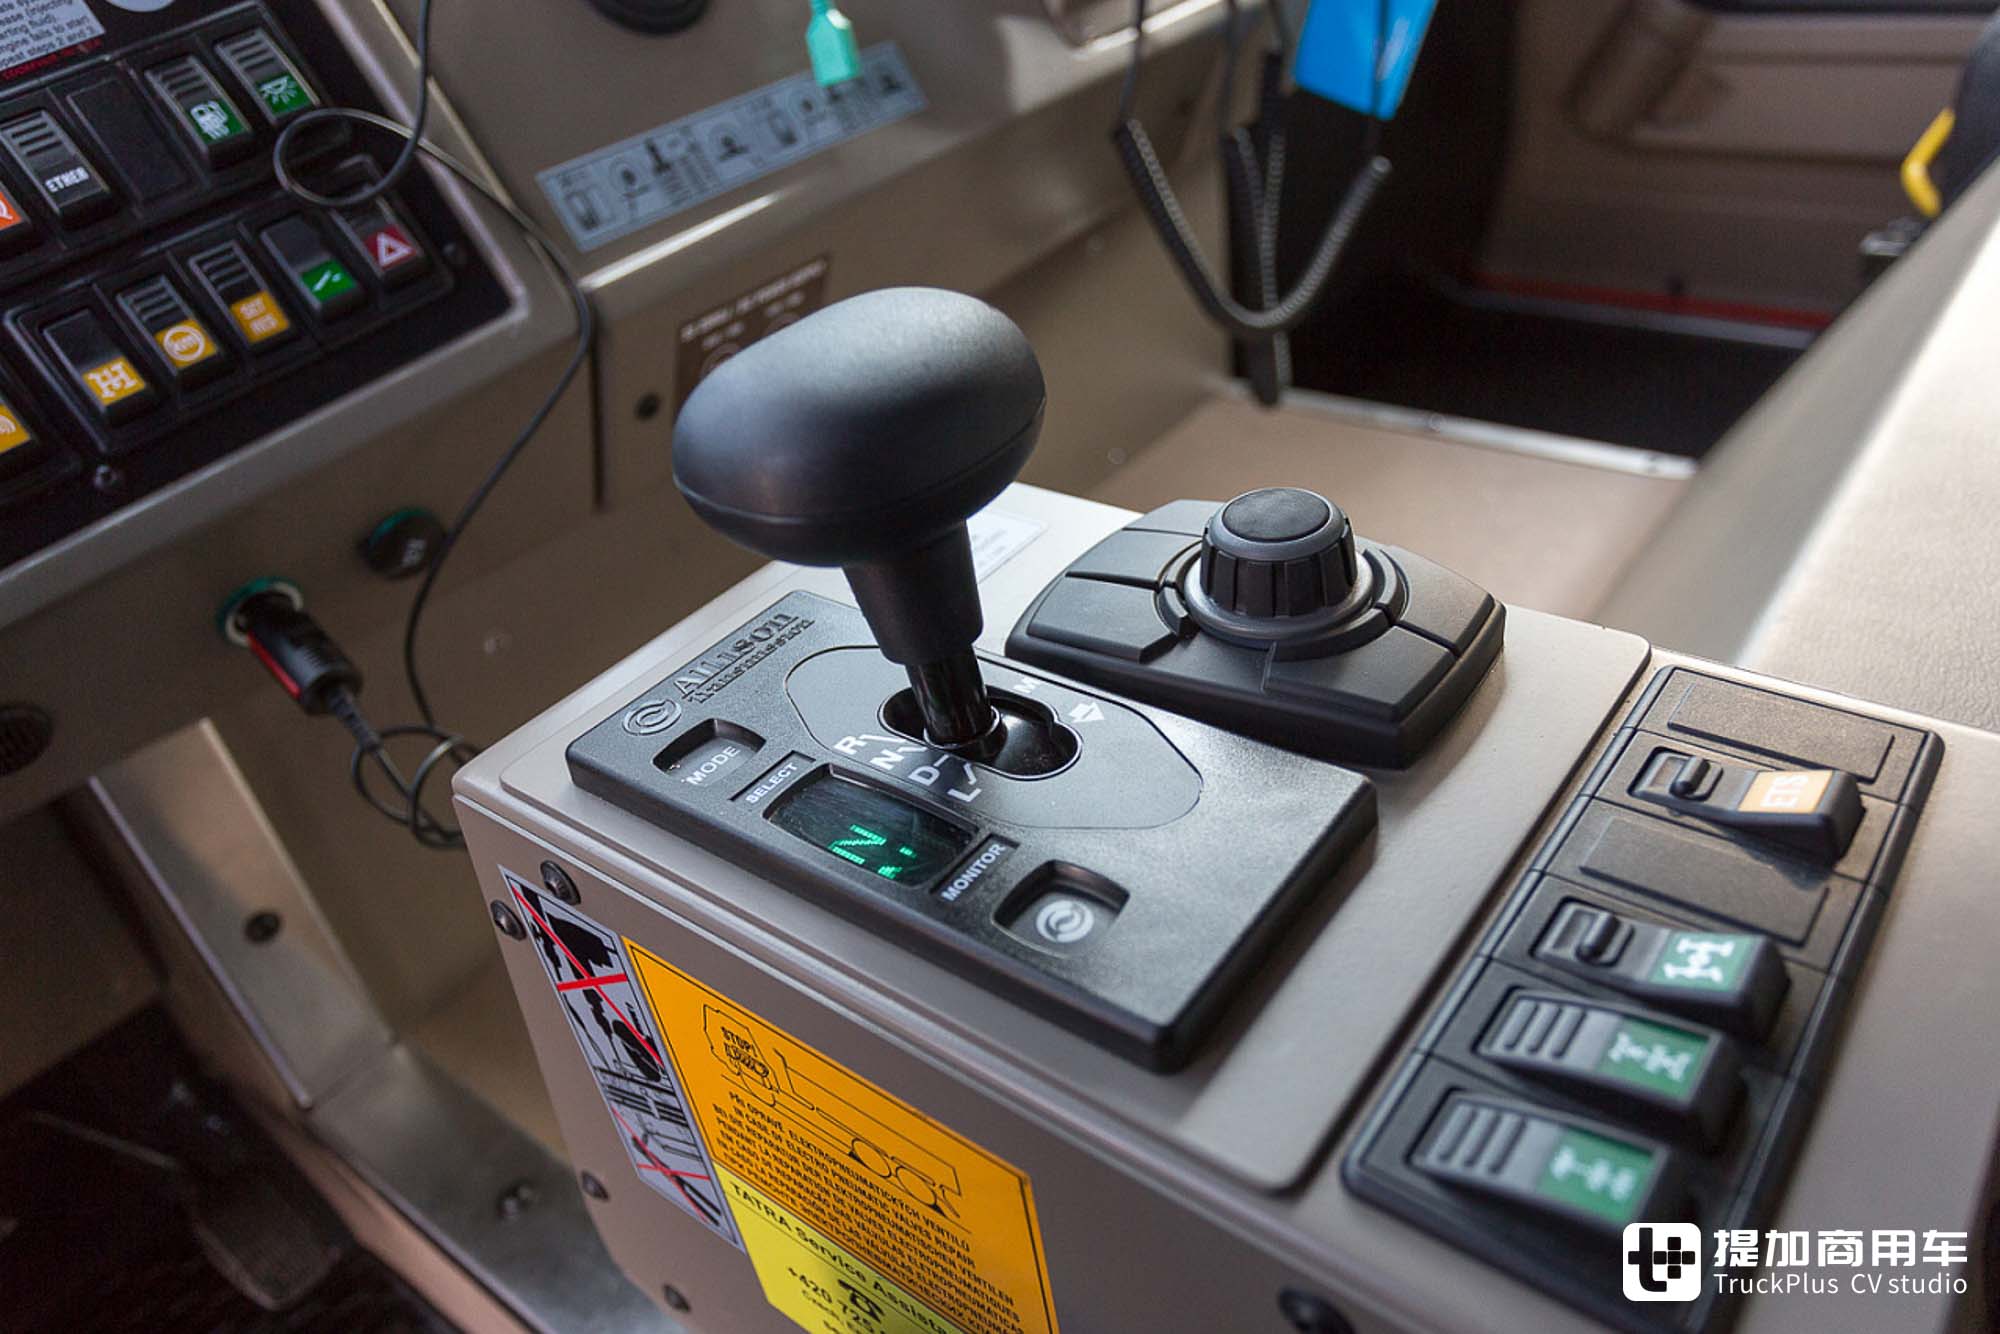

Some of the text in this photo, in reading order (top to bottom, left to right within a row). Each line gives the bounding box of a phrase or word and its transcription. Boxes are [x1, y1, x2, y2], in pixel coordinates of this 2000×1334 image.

[833, 734, 868, 755] R
[870, 748, 905, 771] N
[685, 745, 741, 785] MODE
[745, 761, 798, 804] SELECT
[907, 765, 940, 787] D
[947, 787, 983, 803] L
[941, 842, 1006, 902] MONITOR
[729, 1180, 792, 1231] TATRA
[794, 1223, 867, 1284] Service
[784, 1262, 833, 1305] +420
